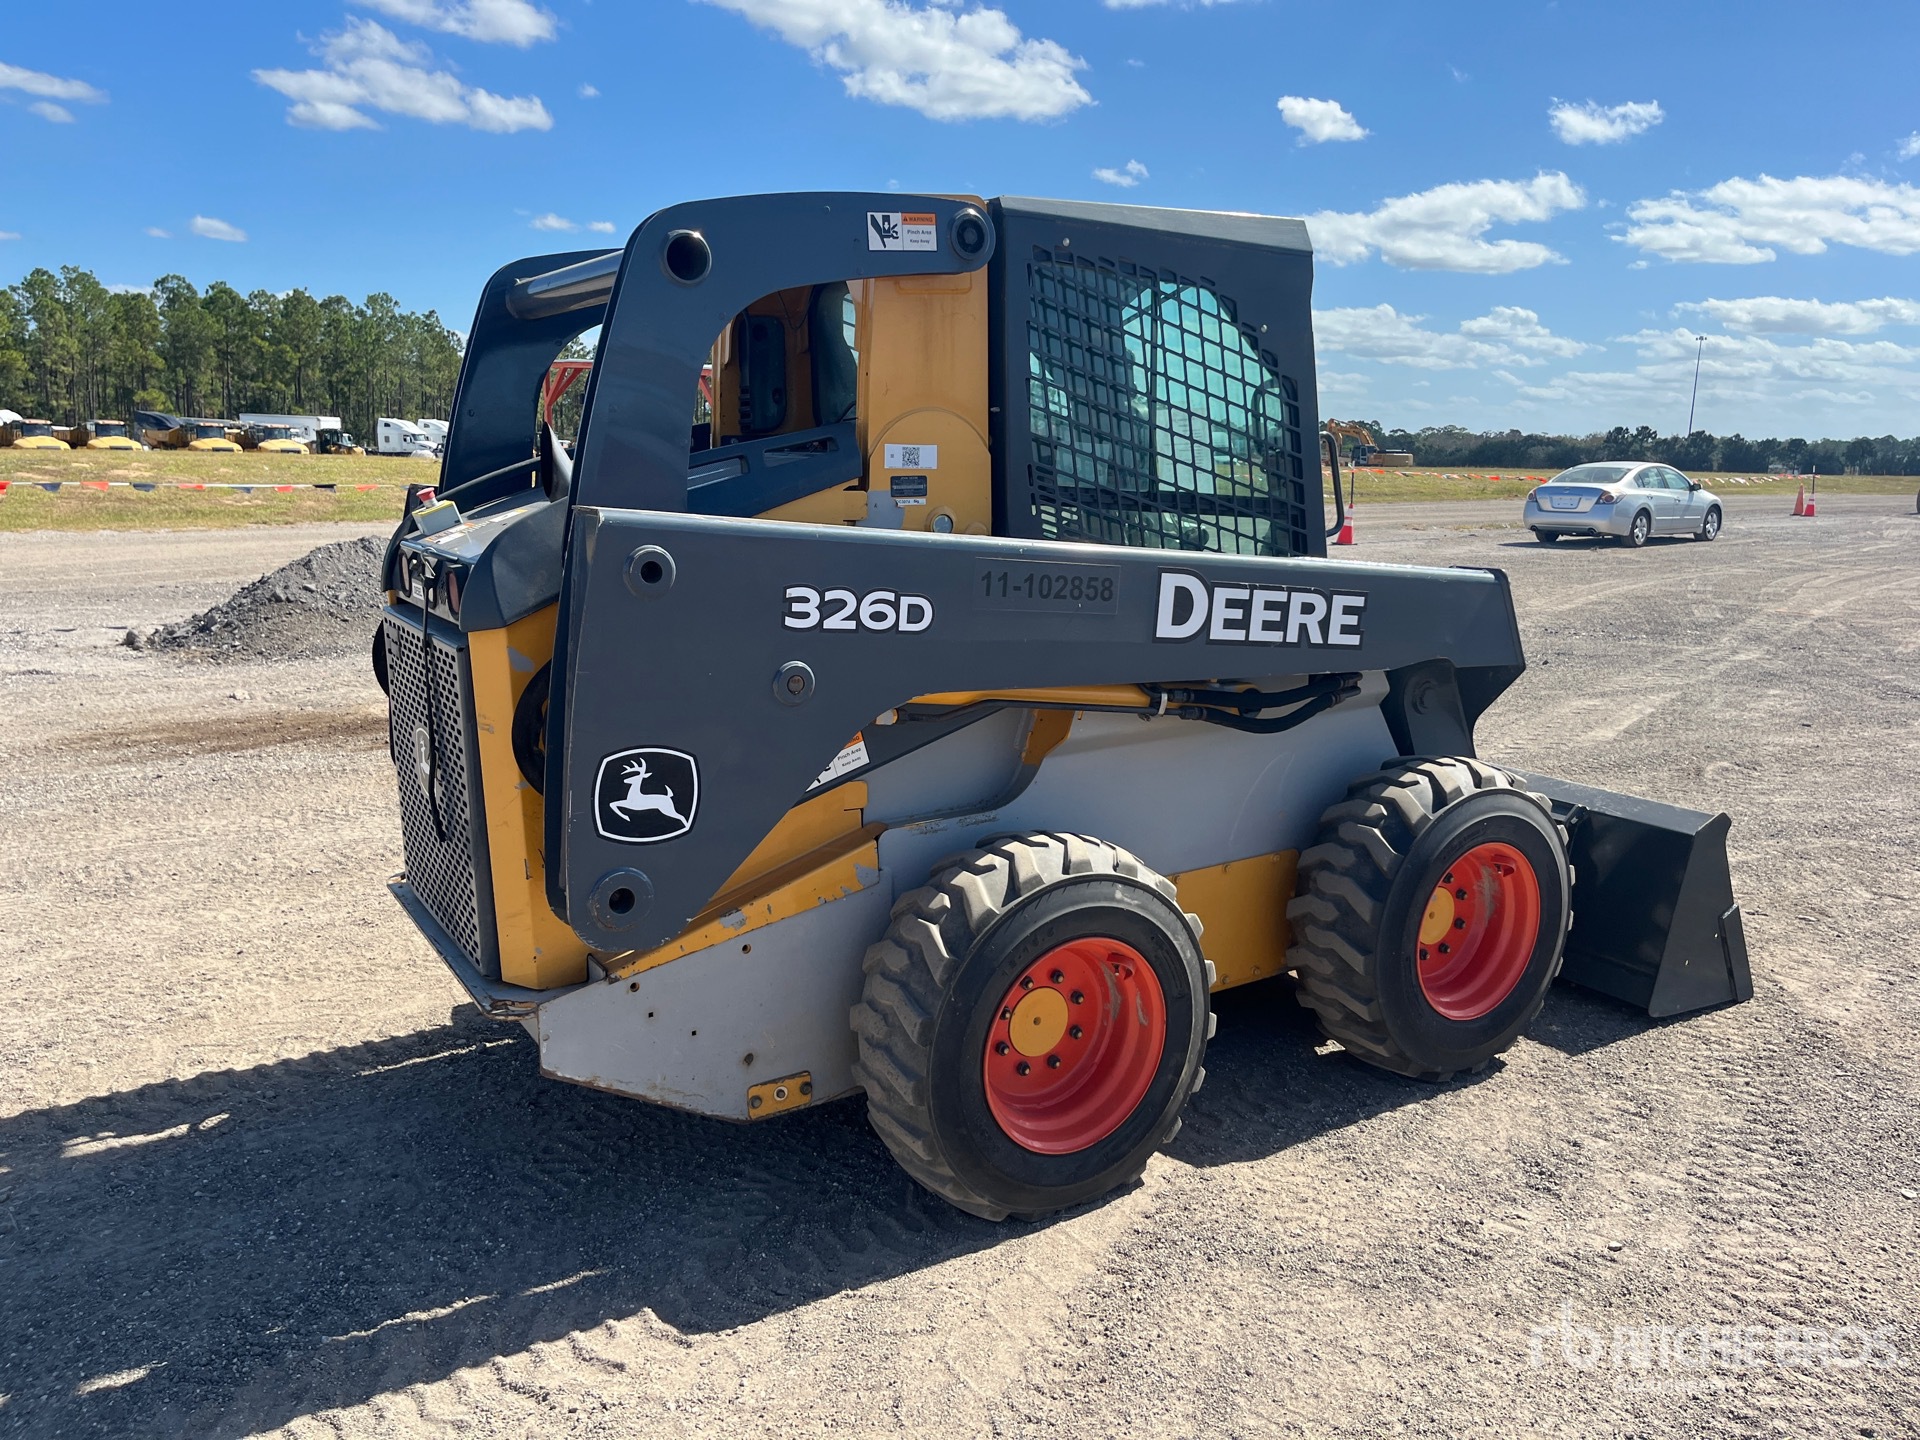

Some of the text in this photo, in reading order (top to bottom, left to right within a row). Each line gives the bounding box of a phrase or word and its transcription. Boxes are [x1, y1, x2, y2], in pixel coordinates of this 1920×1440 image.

[980, 570, 1114, 603] 11-102858
[784, 586, 934, 633] 326D
[1155, 572, 1366, 646] DEERE
[837, 752, 850, 761] Pinch
